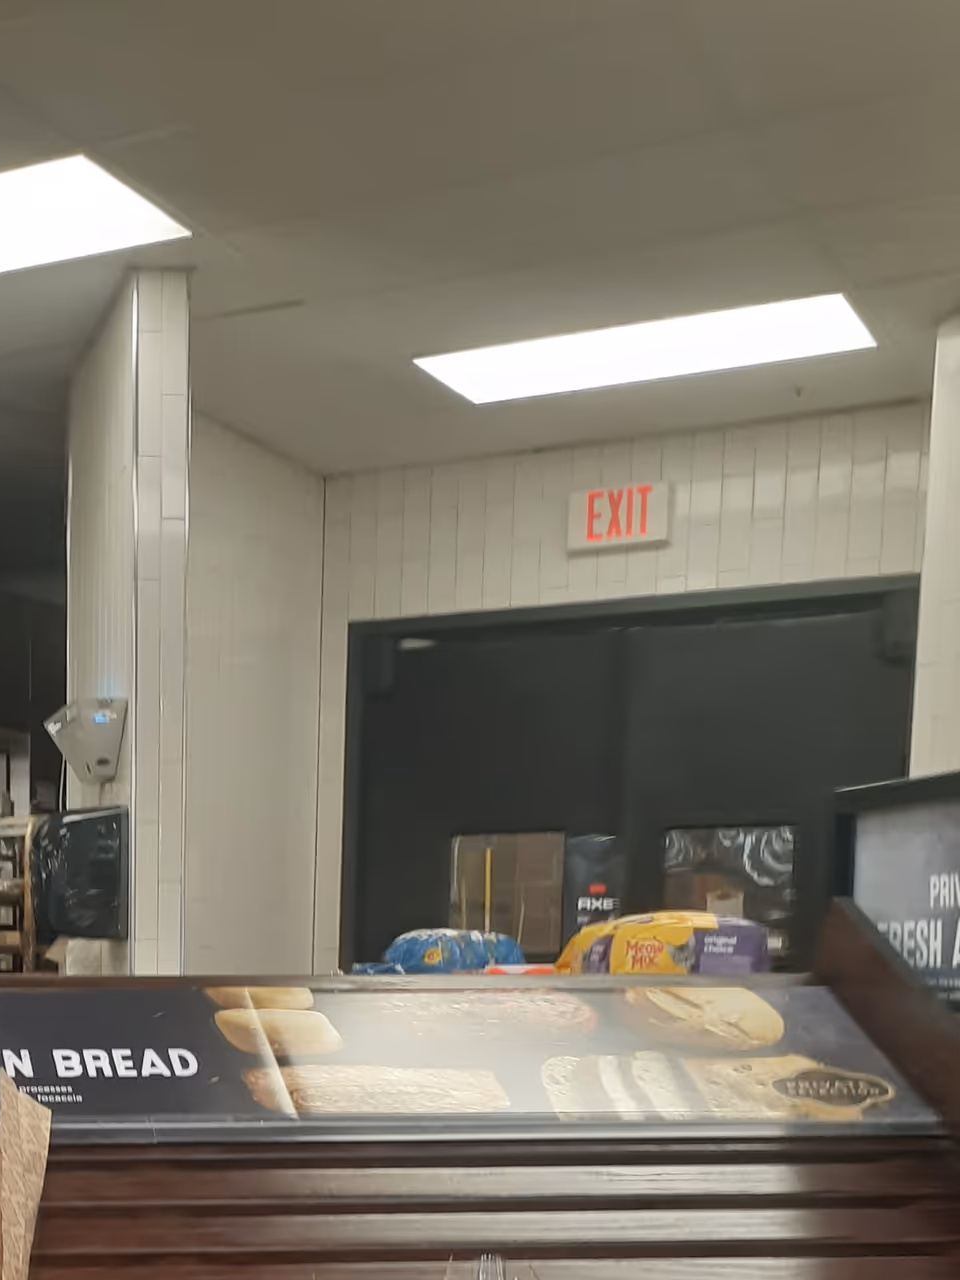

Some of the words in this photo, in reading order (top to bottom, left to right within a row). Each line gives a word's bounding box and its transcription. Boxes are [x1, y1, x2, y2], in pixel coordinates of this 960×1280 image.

[586, 484, 654, 542] EXIT
[625, 938, 665, 955] Meow
[704, 935, 738, 946] original
[877, 918, 943, 969] RESH
[51, 1047, 199, 1079] BREAD
